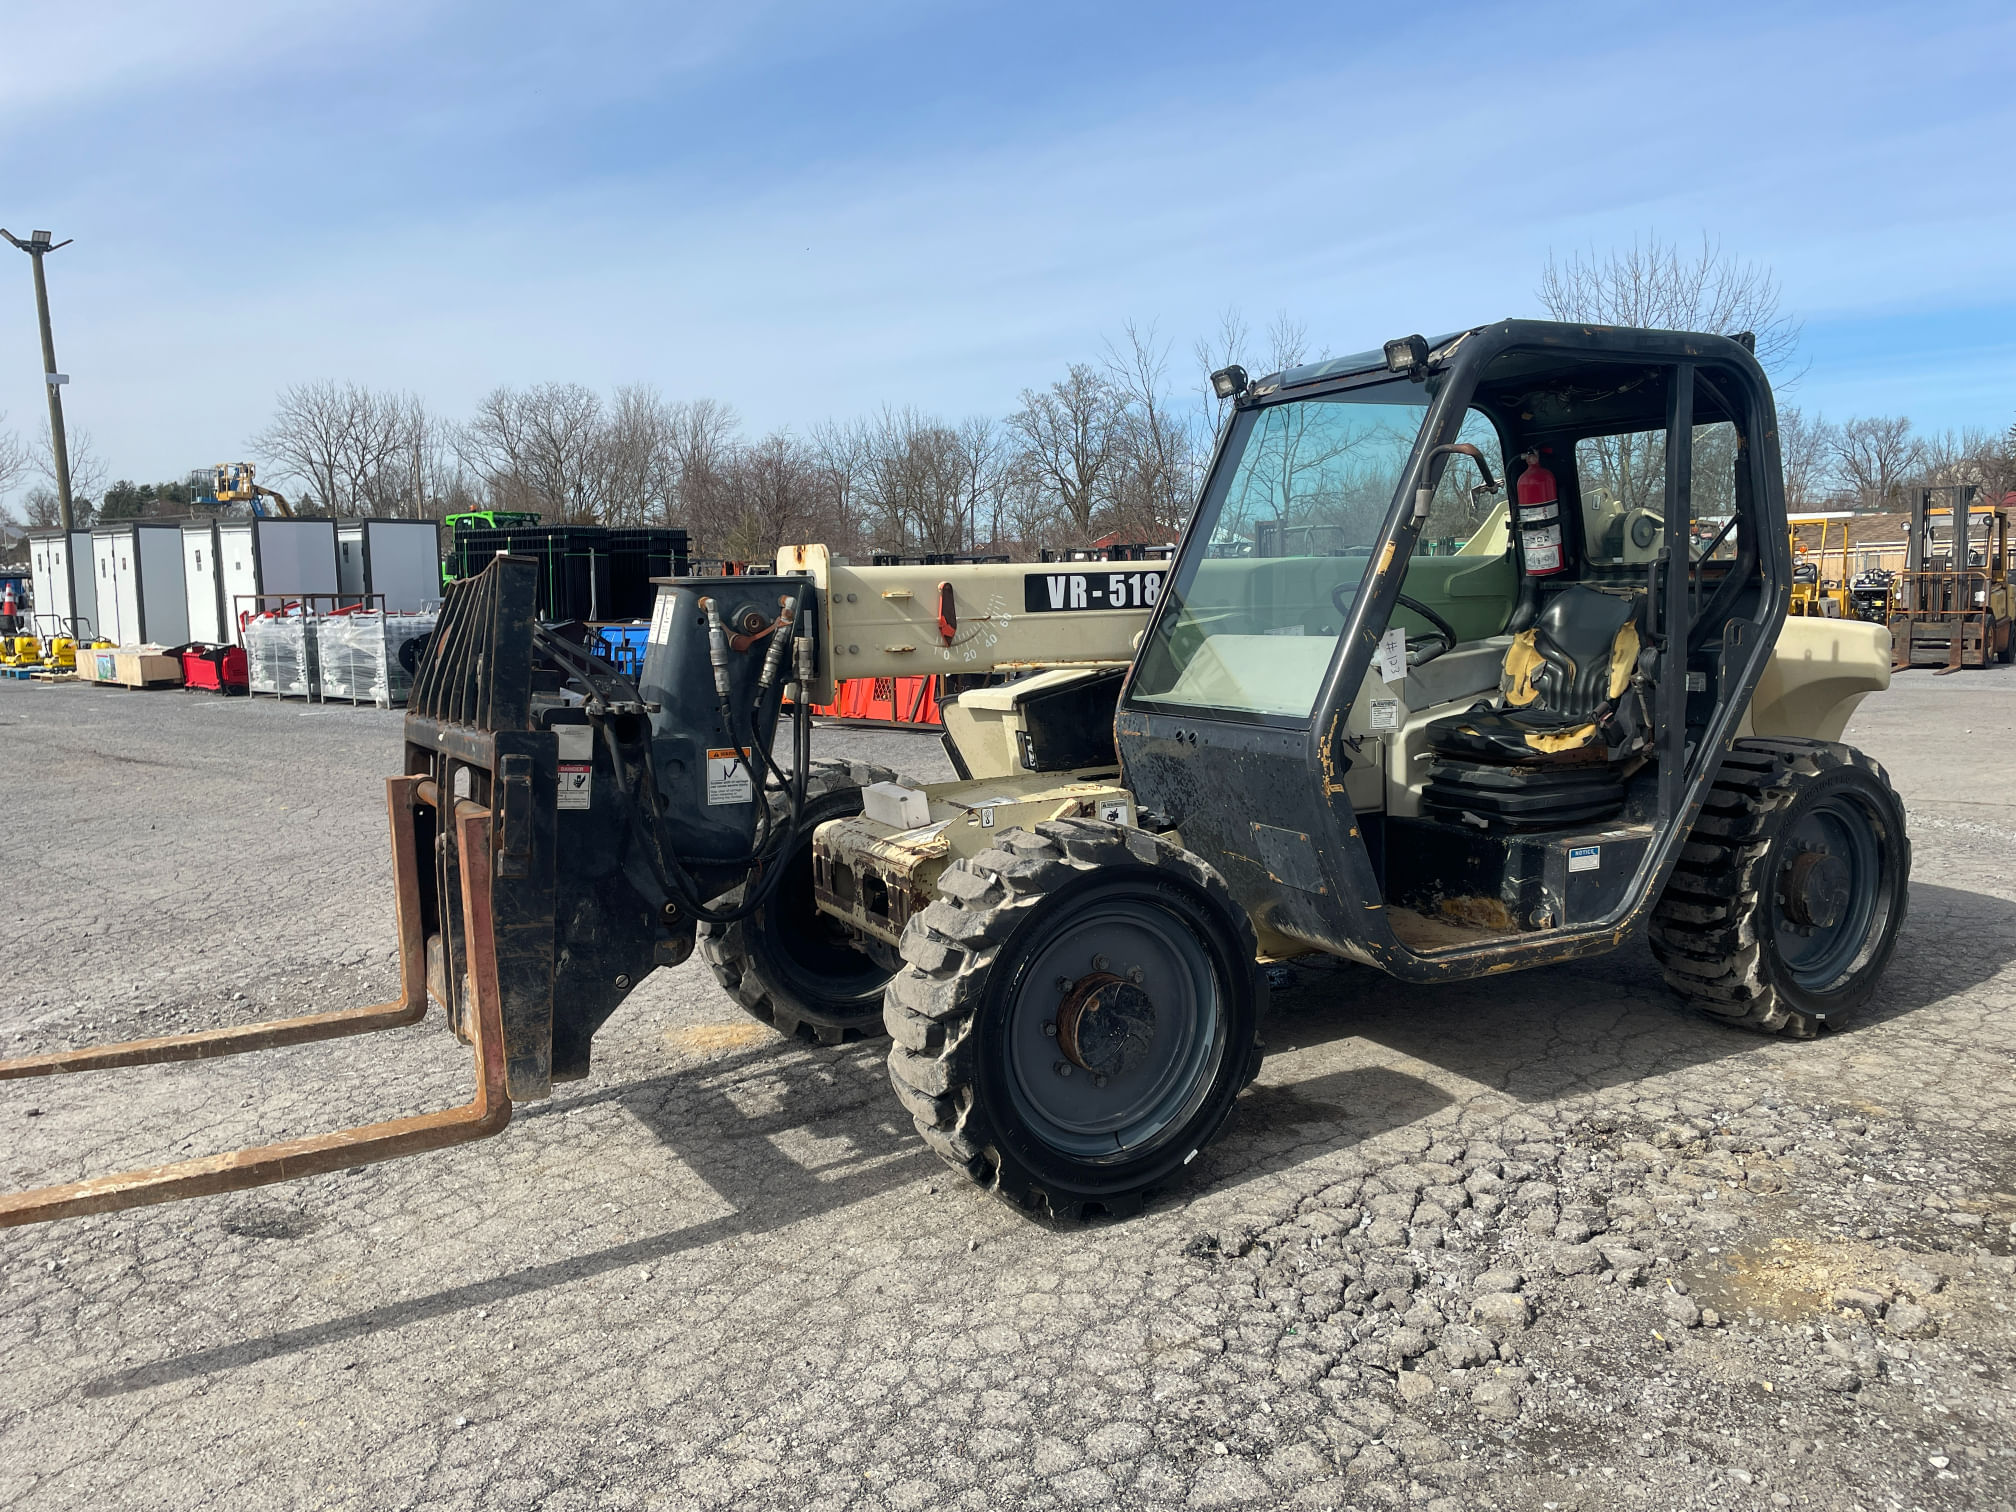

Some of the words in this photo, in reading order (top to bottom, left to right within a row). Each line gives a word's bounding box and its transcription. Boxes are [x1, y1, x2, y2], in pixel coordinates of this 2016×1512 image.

[1046, 572, 1161, 609] VR-518
[1000, 612, 1012, 628] 60
[985, 634, 997, 648] 40
[943, 650, 950, 661] 0
[963, 649, 977, 662] 20
